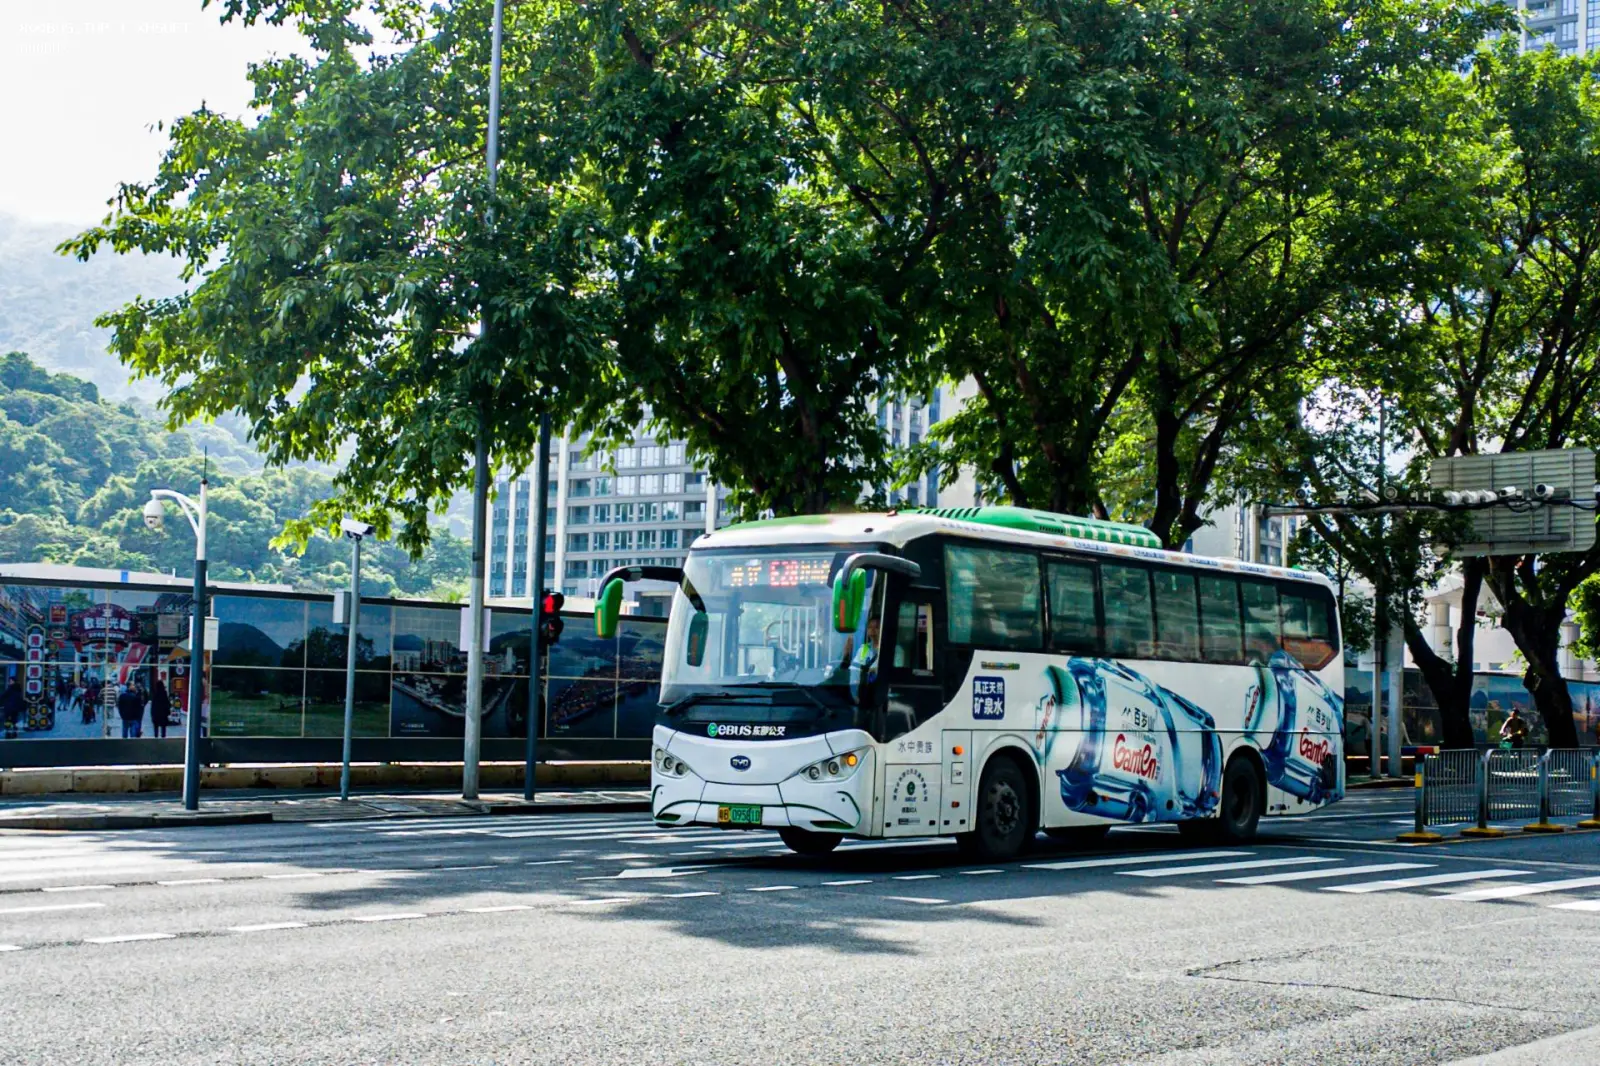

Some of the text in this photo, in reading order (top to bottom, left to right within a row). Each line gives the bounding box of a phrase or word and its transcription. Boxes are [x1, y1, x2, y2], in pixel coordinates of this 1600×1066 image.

[974, 680, 1004, 695] 真正天然
[974, 697, 1004, 716] 矿泉水
[1134, 707, 1155, 732] 百岁山
[752, 725, 786, 736] 东部公交
[897, 740, 933, 755] 水中贵族
